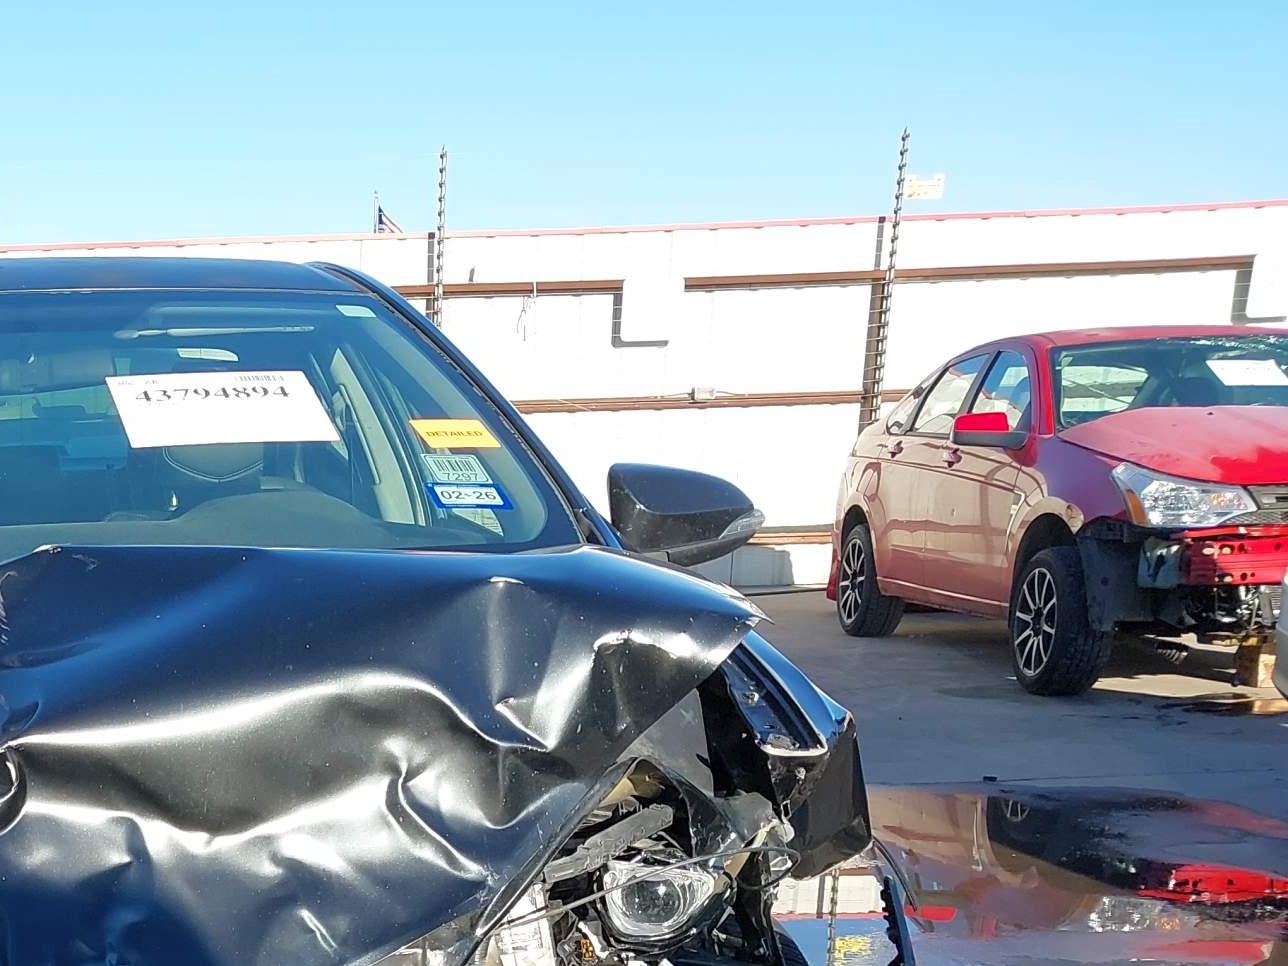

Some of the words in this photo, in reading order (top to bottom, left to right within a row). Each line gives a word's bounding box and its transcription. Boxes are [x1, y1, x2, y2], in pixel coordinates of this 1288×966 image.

[135, 385, 290, 402] 43794894
[425, 430, 483, 438] DETAILED
[442, 472, 479, 481] 7297
